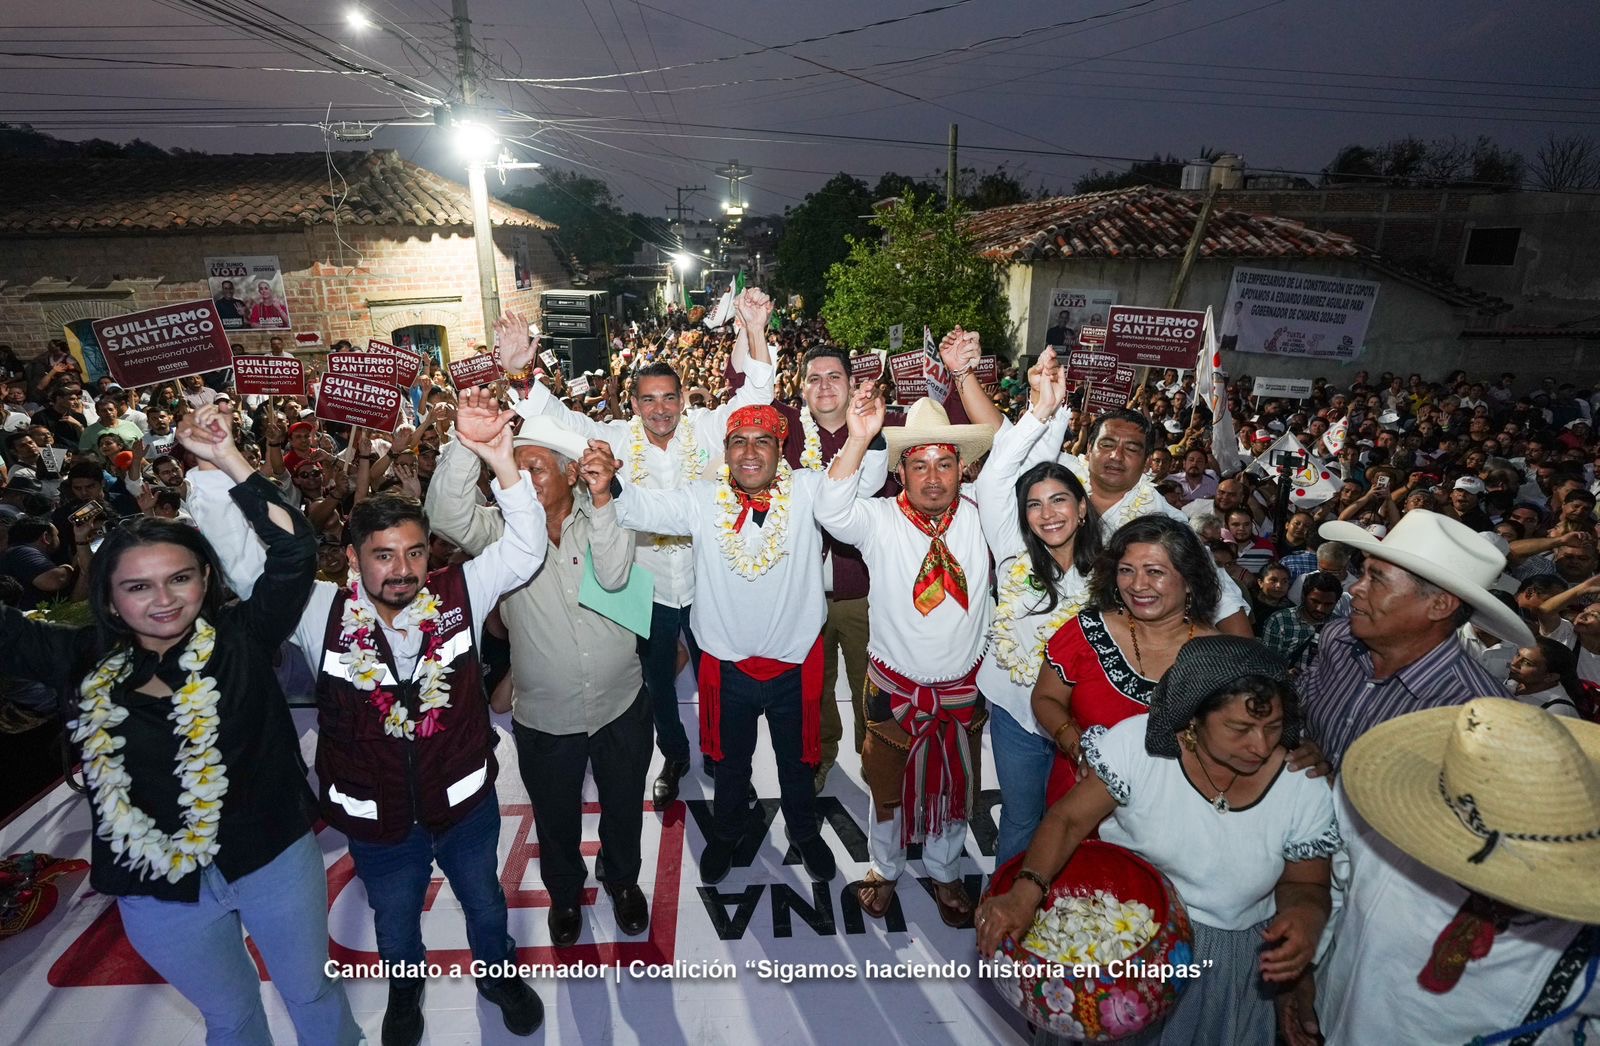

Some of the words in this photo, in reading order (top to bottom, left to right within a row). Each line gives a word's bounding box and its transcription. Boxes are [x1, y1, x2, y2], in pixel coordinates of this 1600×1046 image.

[212, 267, 247, 277] VOTA
[1248, 273, 1286, 287] EMPRESARIOS
[1287, 278, 1295, 288] DE
[1295, 279, 1303, 289] LA
[1345, 284, 1353, 294] DE
[1055, 299, 1086, 307] VOTA
[1240, 288, 1269, 302] APOYAMOS
[1271, 291, 1276, 301] A
[1276, 291, 1301, 305] EDUARDO
[1326, 298, 1350, 310] AGUILAR
[1350, 301, 1364, 312] PARA
[1113, 313, 1199, 328] GUILLERMO
[1251, 305, 1287, 319] GOBERNADOR
[1288, 309, 1296, 320] DE
[1296, 310, 1320, 322] CHIAPAS
[102, 308, 211, 338] GUILLERMO
[106, 320, 214, 351] SANTIAGO
[1112, 323, 1196, 339] SANTIAGO
[124, 342, 214, 367] #MemocionaTUXTLA
[371, 342, 419, 364] GUILLERMO
[1072, 353, 1116, 362] GUILLERMO
[157, 360, 188, 372] morena
[237, 359, 299, 368] GUILLERMO
[332, 356, 394, 366] GUILLERMO
[451, 355, 492, 370] GUILLERMO
[452, 361, 493, 376] SANTIAGO
[1071, 359, 1115, 368] SANTIAGO
[238, 366, 299, 375] SANTIAGO
[333, 364, 394, 374] SANTIAGO
[326, 377, 398, 399] GUILLERMO
[324, 385, 396, 408] SANTIAGO
[696, 881, 907, 940] UNA
